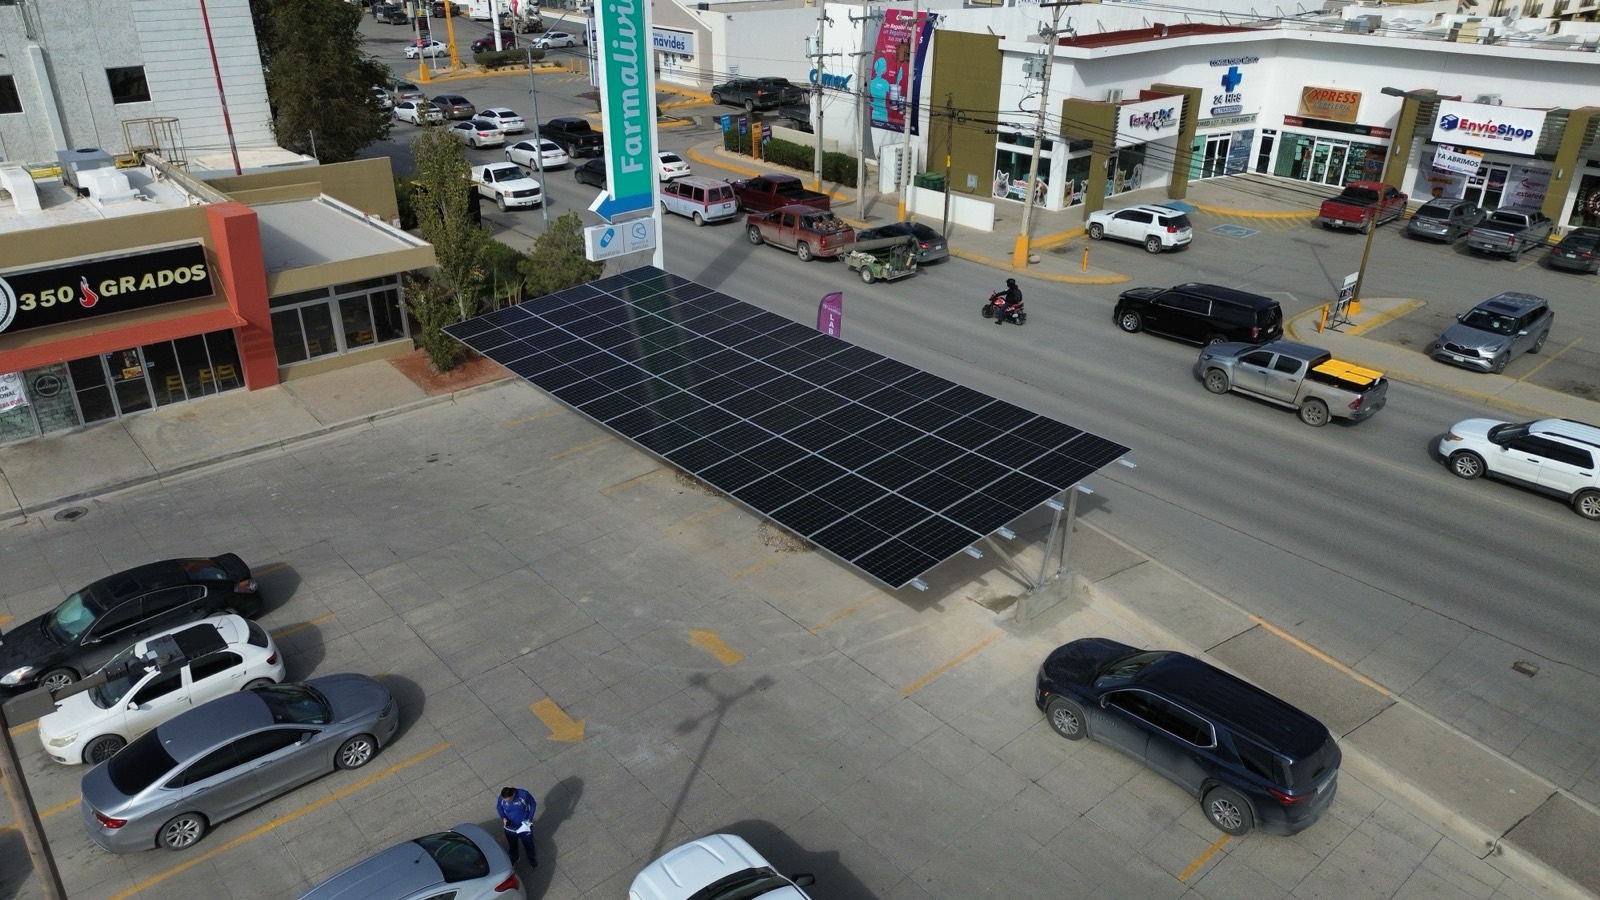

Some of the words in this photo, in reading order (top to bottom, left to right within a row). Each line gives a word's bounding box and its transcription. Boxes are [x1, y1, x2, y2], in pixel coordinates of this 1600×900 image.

[653, 35, 685, 50] navides
[609, 0, 644, 174] Farmalivi
[809, 69, 853, 90] Cmex
[1213, 94, 1223, 105] 24
[1225, 93, 1242, 104] HRS
[1312, 89, 1358, 104] XPRESS
[1447, 154, 1479, 167] ABRIMOS
[20, 286, 74, 310] 350
[100, 264, 207, 297] GRADOS
